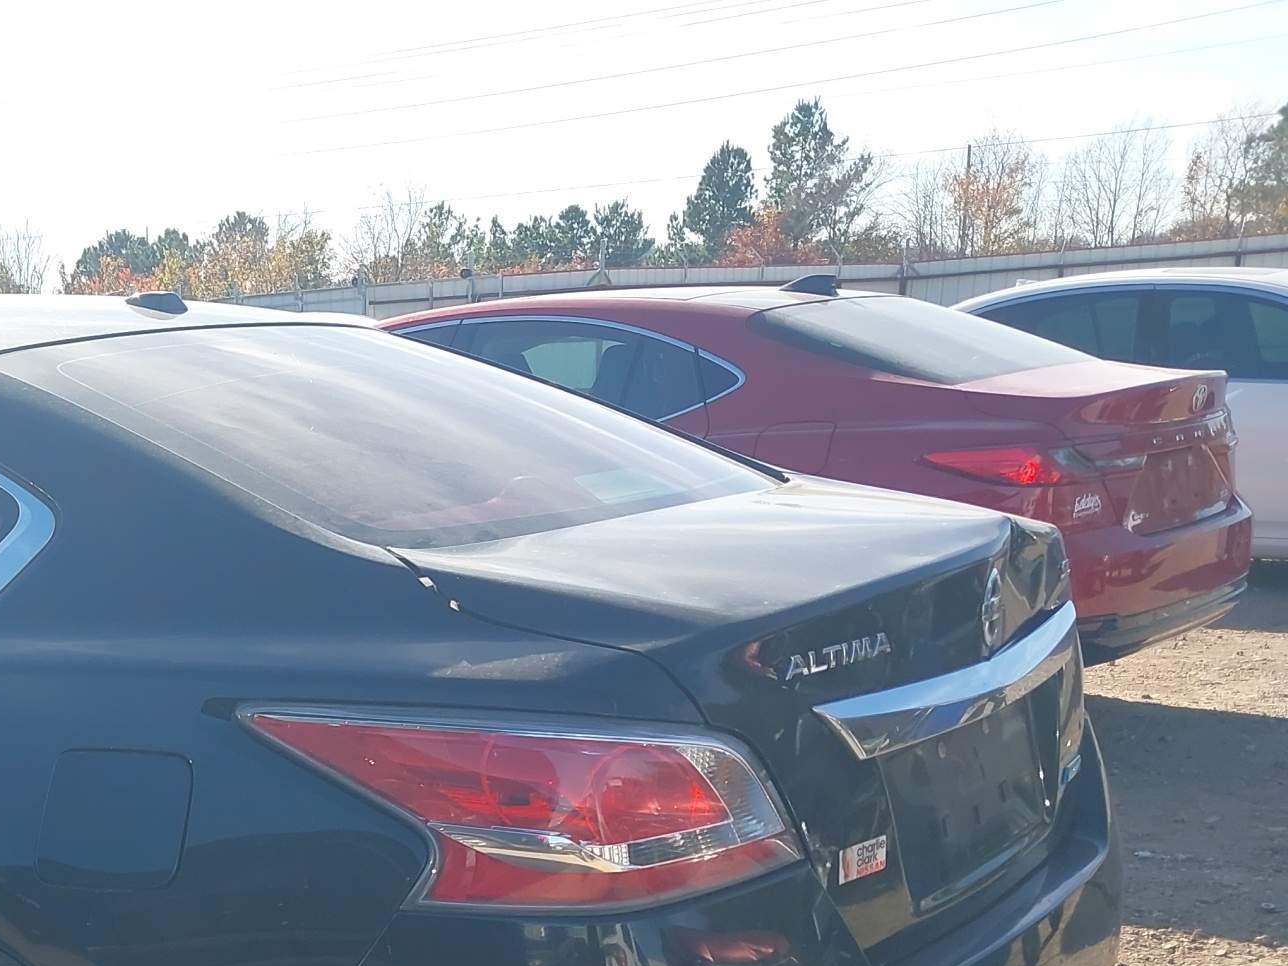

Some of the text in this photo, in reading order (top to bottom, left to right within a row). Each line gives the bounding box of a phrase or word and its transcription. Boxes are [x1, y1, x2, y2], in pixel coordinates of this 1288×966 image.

[1152, 414, 1228, 445] CAM
[785, 632, 892, 681] ALTIMA
[856, 839, 886, 858] charlie
[856, 860, 886, 876] NISSAN
